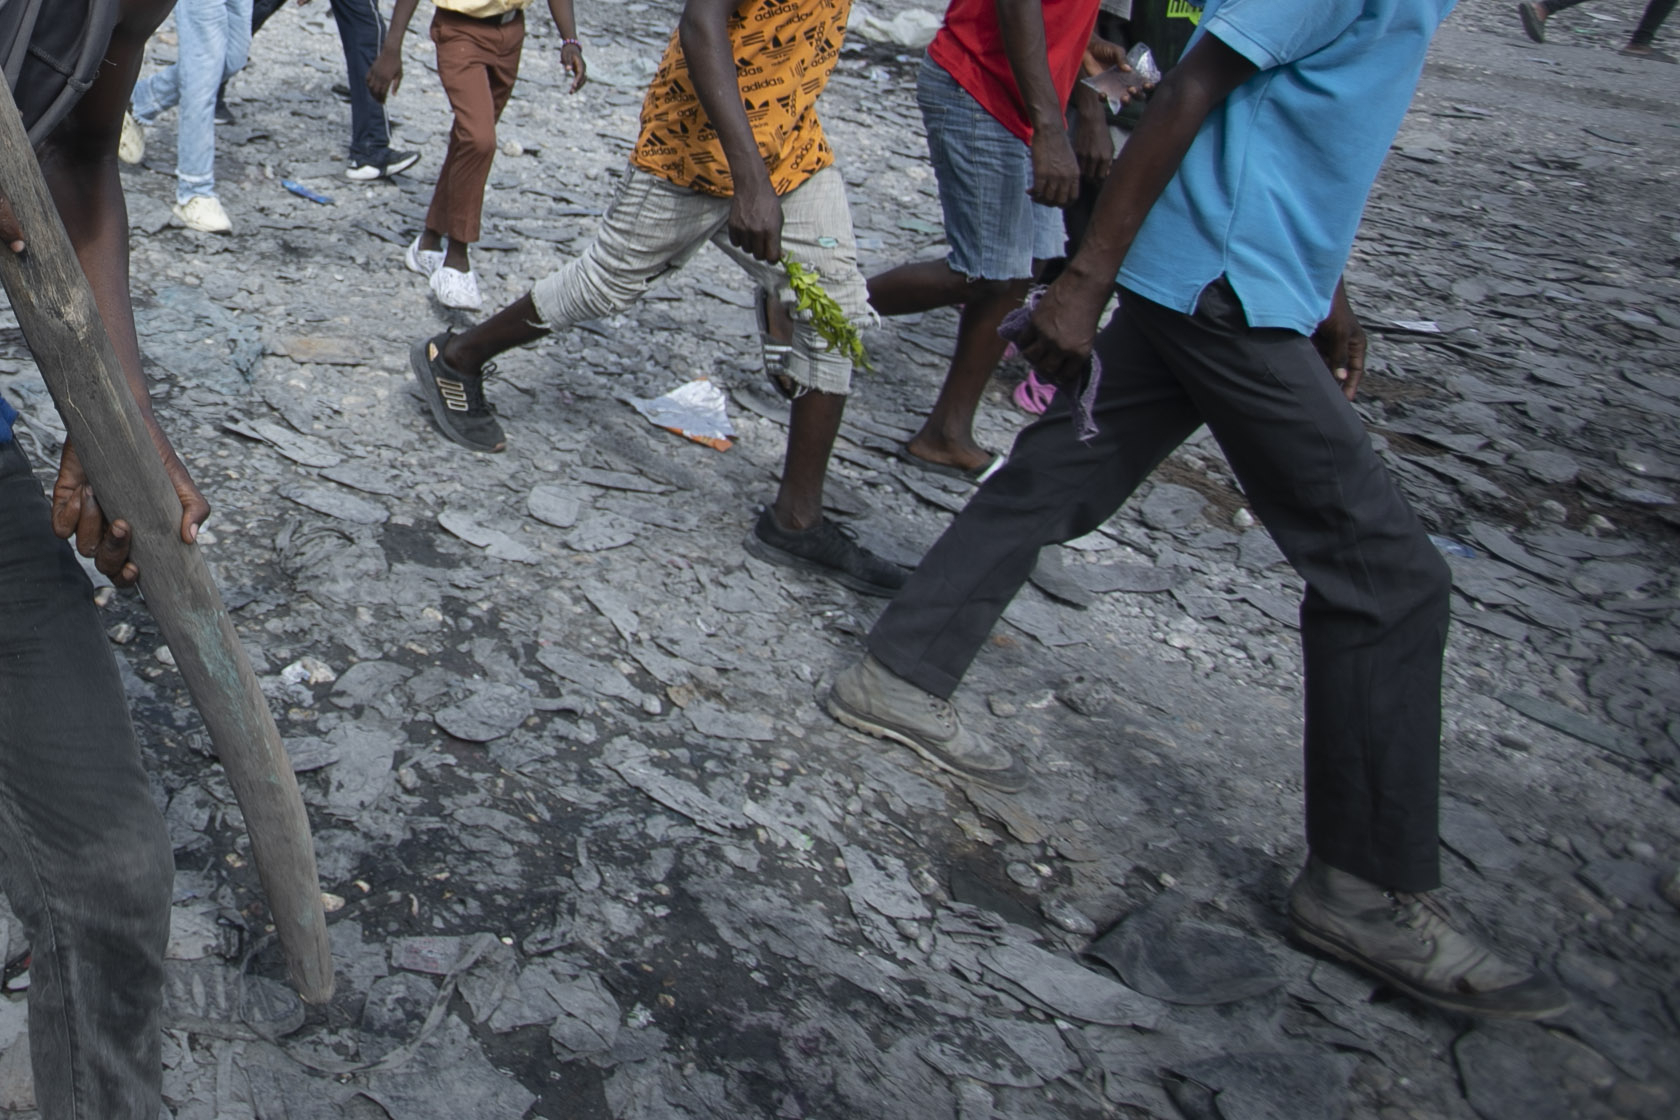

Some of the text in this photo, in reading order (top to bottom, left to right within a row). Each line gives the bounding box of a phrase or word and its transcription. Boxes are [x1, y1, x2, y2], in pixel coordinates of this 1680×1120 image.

[754, 2, 799, 22] adidas
[741, 77, 785, 93] adidas
[641, 146, 678, 157] adidas
